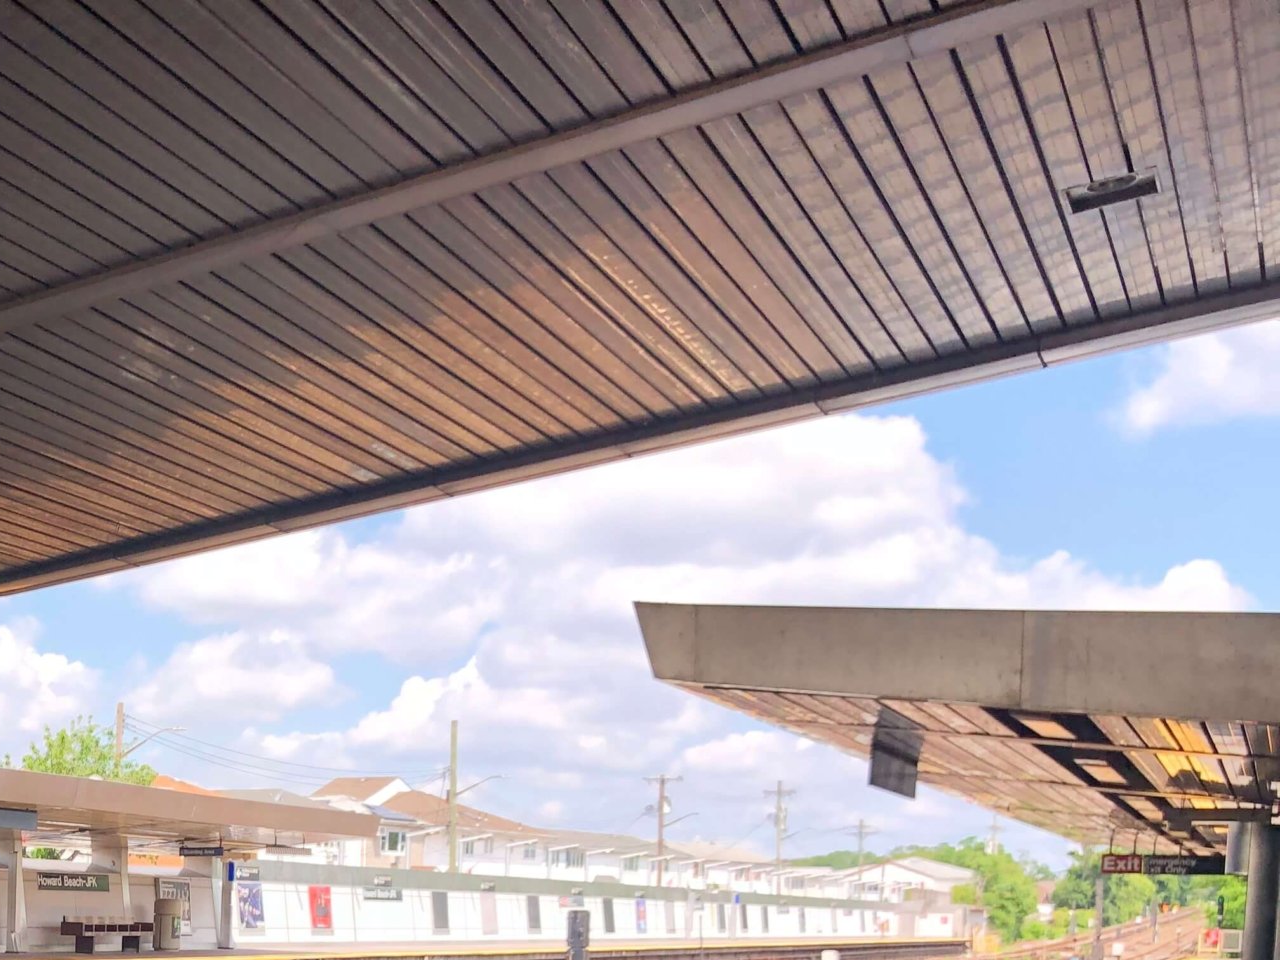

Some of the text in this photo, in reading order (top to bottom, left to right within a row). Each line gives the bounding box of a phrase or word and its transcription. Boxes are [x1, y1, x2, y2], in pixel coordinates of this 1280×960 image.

[1103, 856, 1140, 871] Exit
[37, 873, 98, 888] Howard Beach-JFK
